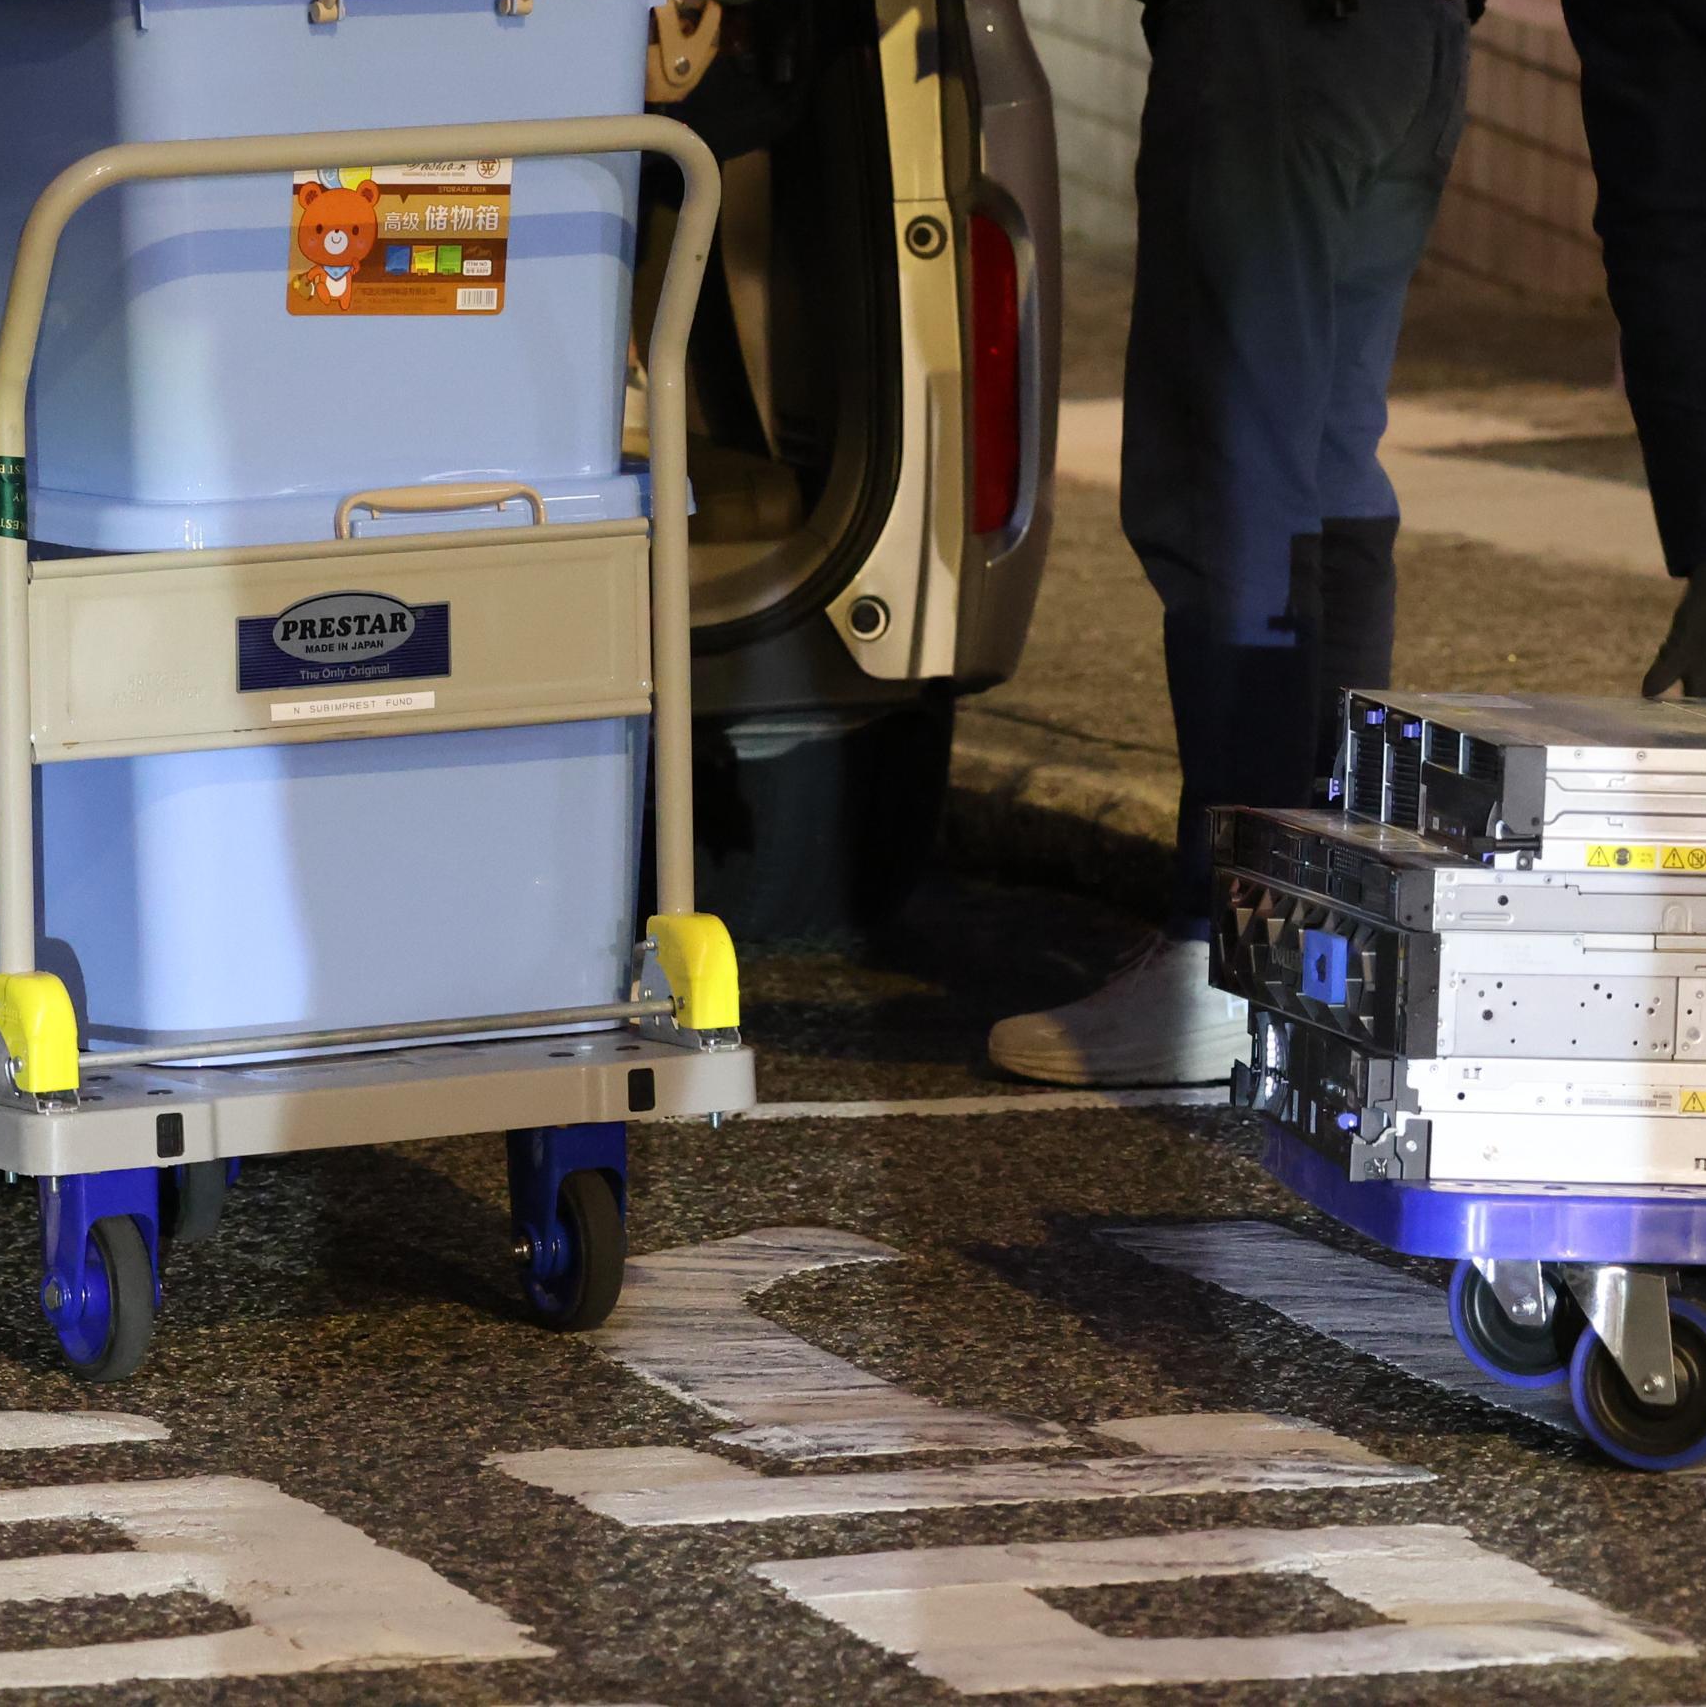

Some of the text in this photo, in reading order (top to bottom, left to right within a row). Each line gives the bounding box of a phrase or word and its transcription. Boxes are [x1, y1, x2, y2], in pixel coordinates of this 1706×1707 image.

[438, 185, 470, 194] STORAGE
[384, 204, 501, 232] 高级 储物箱
[281, 611, 408, 642] PRESTAR
[305, 638, 385, 654] MADE IN JAPAN
[300, 662, 390, 680] The Only Original
[309, 699, 376, 714] SUBIMPREST
[385, 696, 414, 708] FUND
